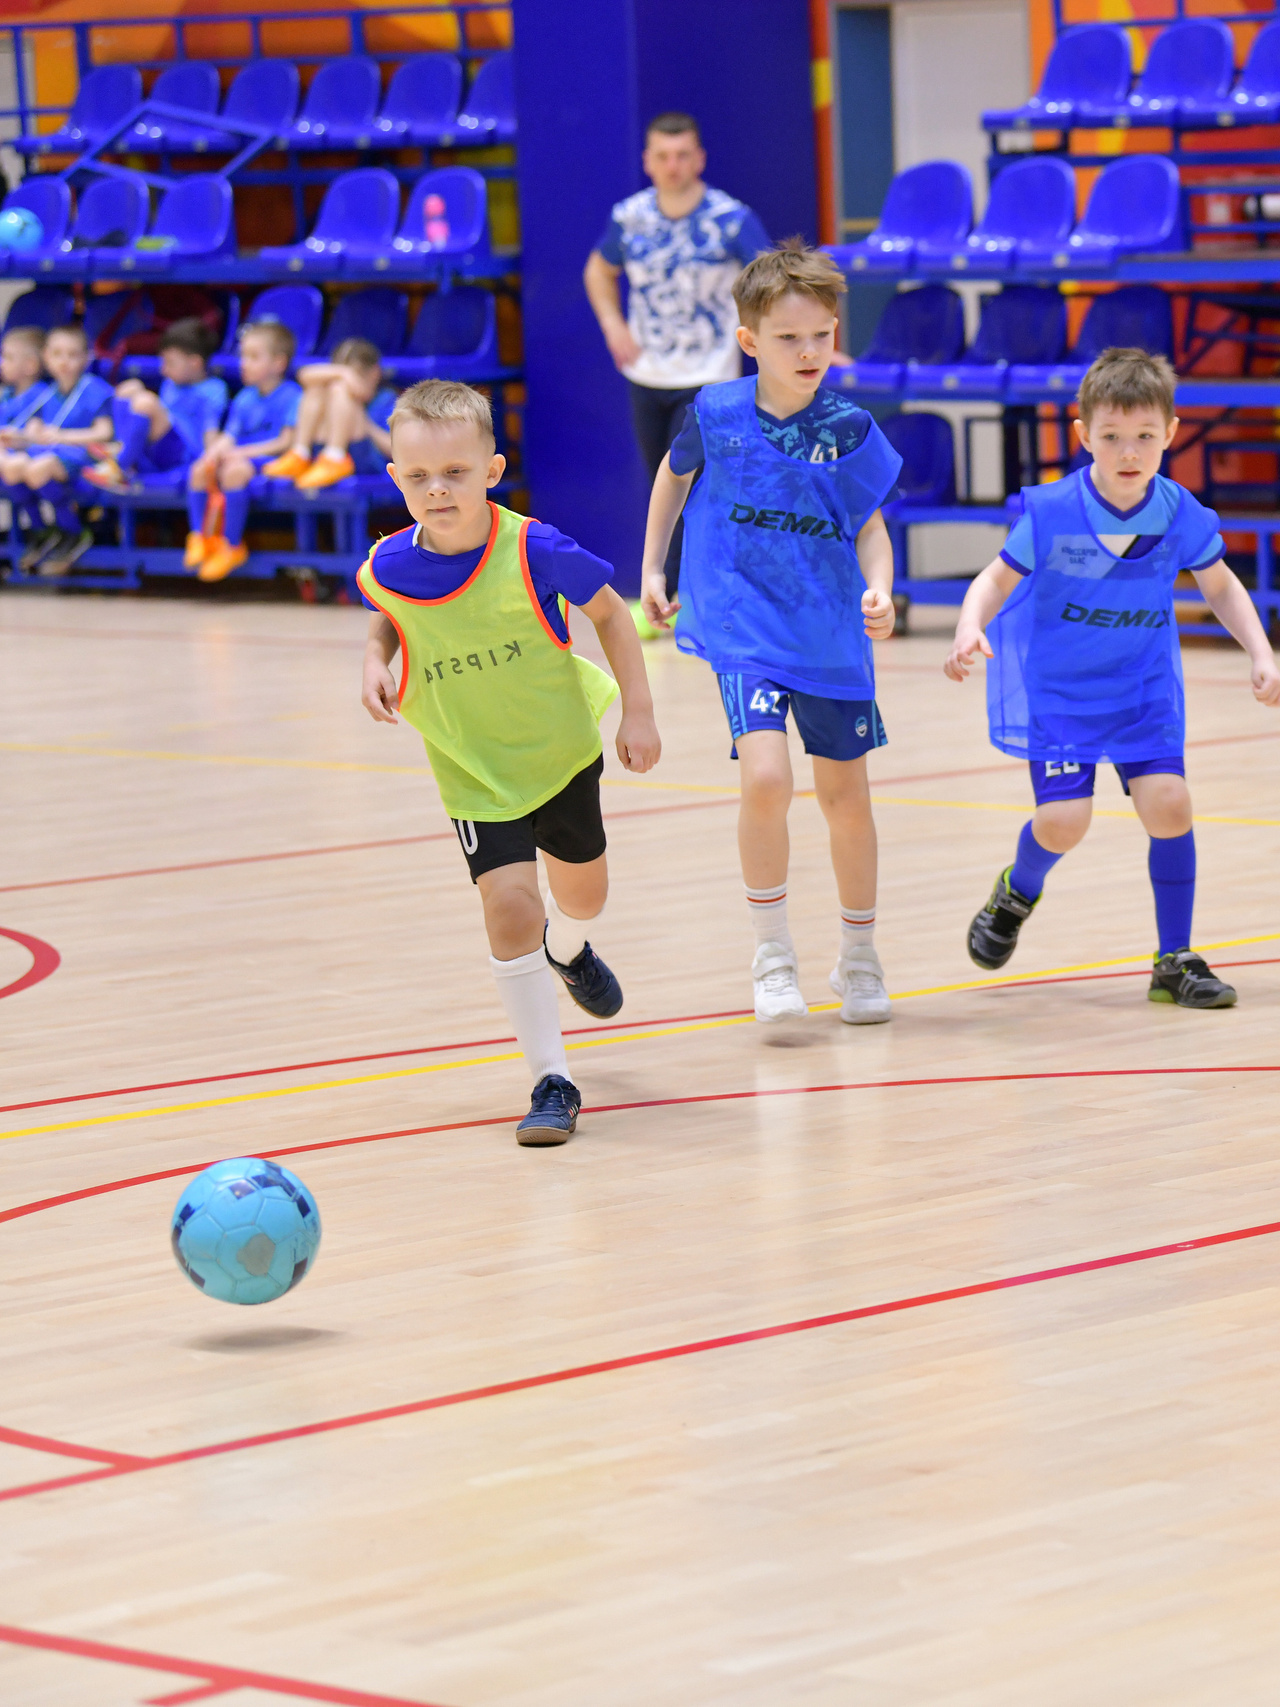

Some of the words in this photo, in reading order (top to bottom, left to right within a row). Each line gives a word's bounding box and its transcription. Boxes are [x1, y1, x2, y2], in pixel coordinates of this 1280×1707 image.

[809, 443, 839, 466] 41
[728, 503, 842, 542] DEMIX
[1060, 602, 1171, 629] DEMIX
